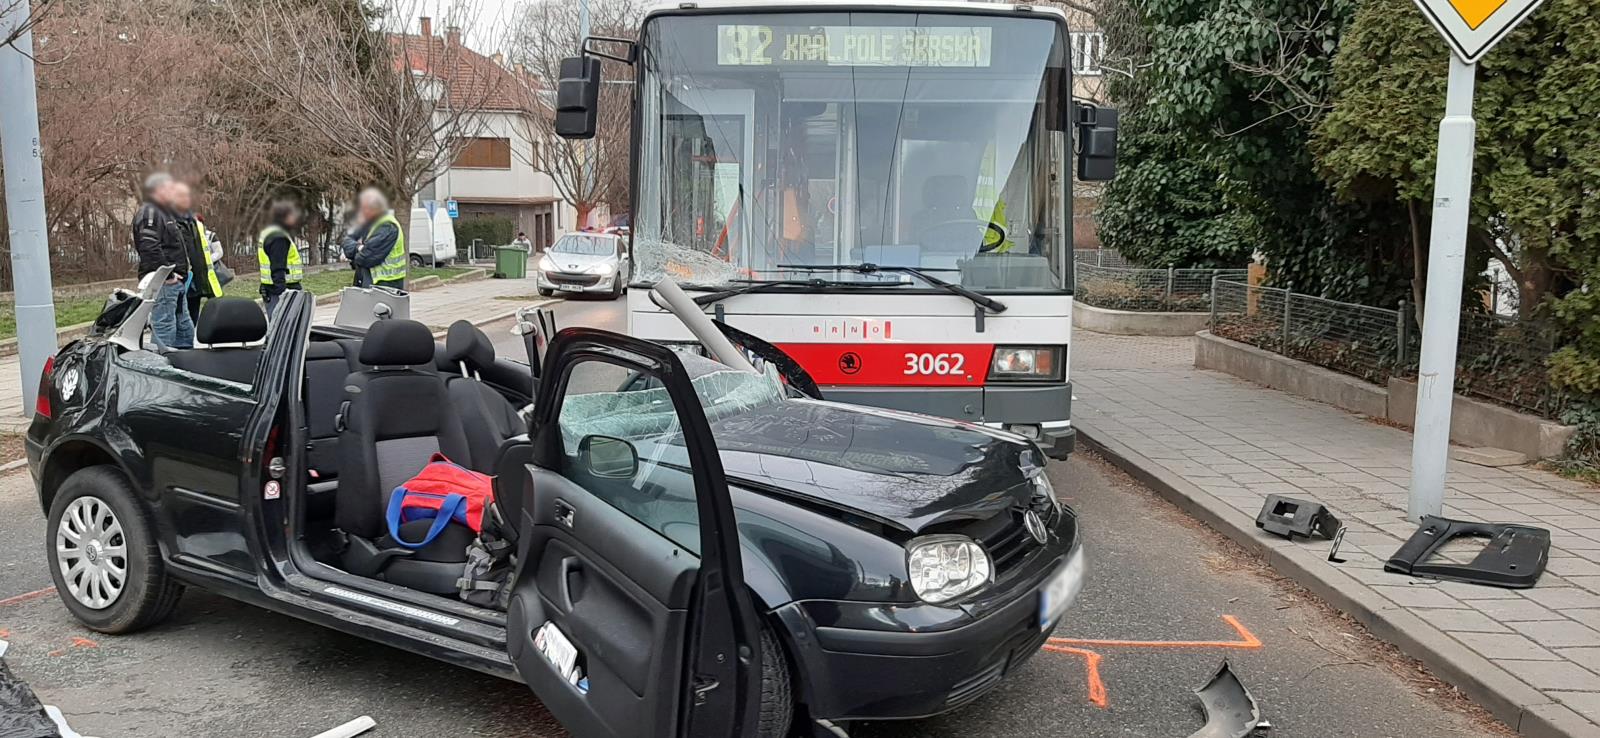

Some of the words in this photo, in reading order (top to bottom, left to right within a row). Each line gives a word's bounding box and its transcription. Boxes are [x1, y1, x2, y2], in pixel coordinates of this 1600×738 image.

[727, 25, 773, 65] 32
[844, 34, 893, 62] POLE
[903, 352, 965, 375] 3062
